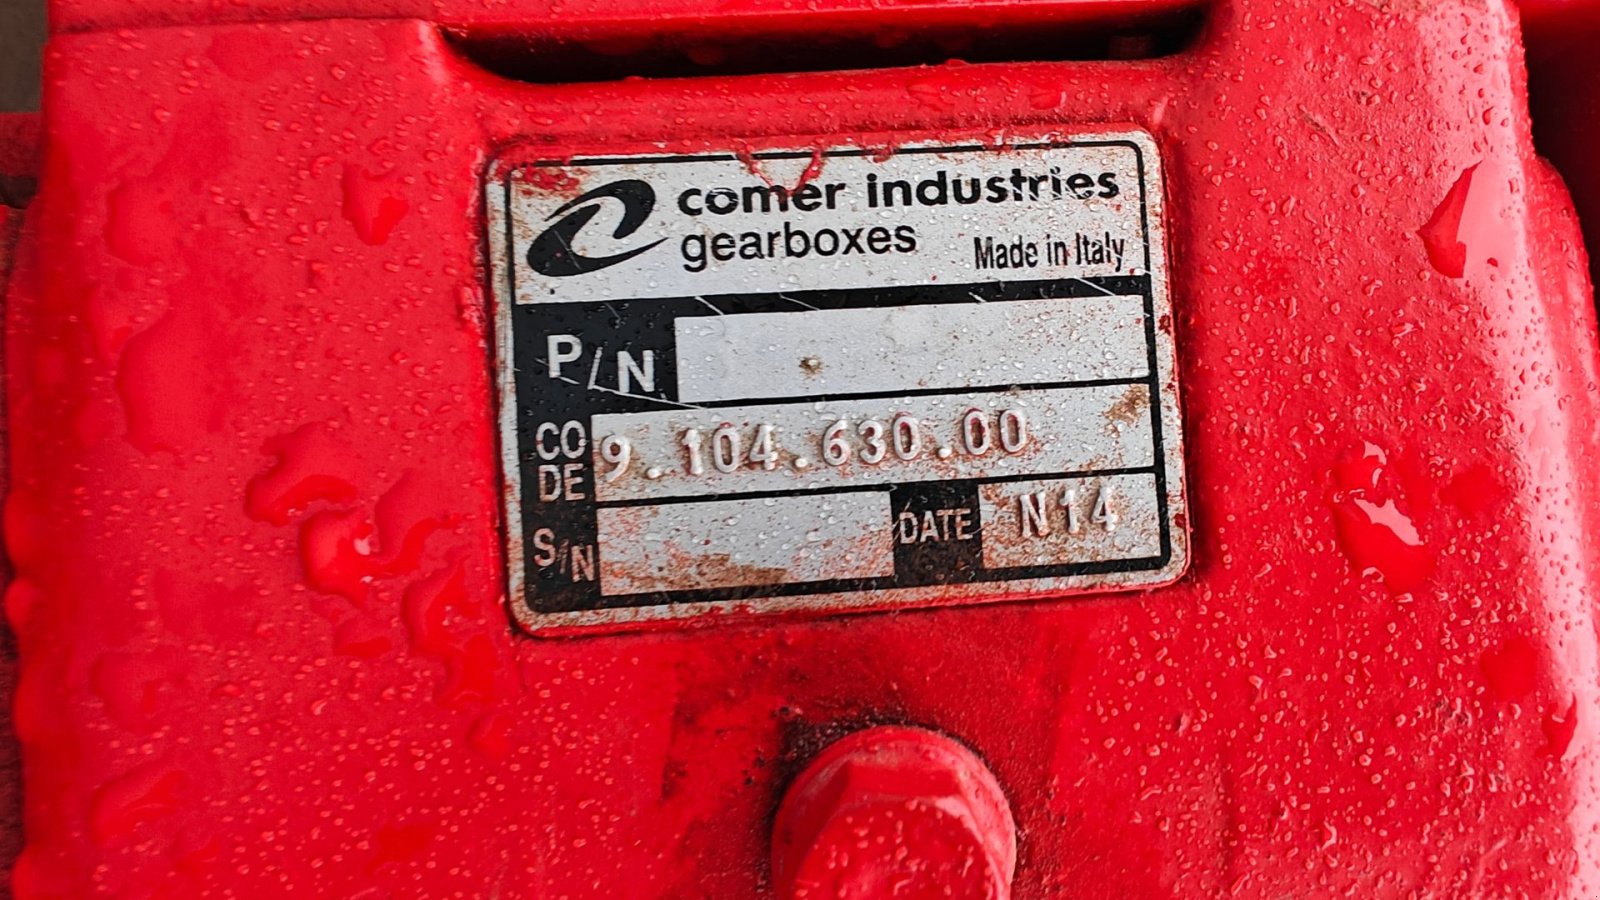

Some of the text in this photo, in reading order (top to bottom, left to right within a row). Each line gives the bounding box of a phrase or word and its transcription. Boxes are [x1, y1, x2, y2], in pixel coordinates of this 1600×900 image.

[678, 167, 1119, 215] comer industries
[680, 220, 917, 272] gearboxes
[974, 231, 1125, 272] Made in Italy
[546, 333, 656, 394] P/N
[535, 420, 586, 461] CO
[601, 407, 1029, 482] 9.104.630.00
[538, 464, 586, 502] DE
[899, 508, 974, 545] DATE
[533, 526, 596, 582] S/N
